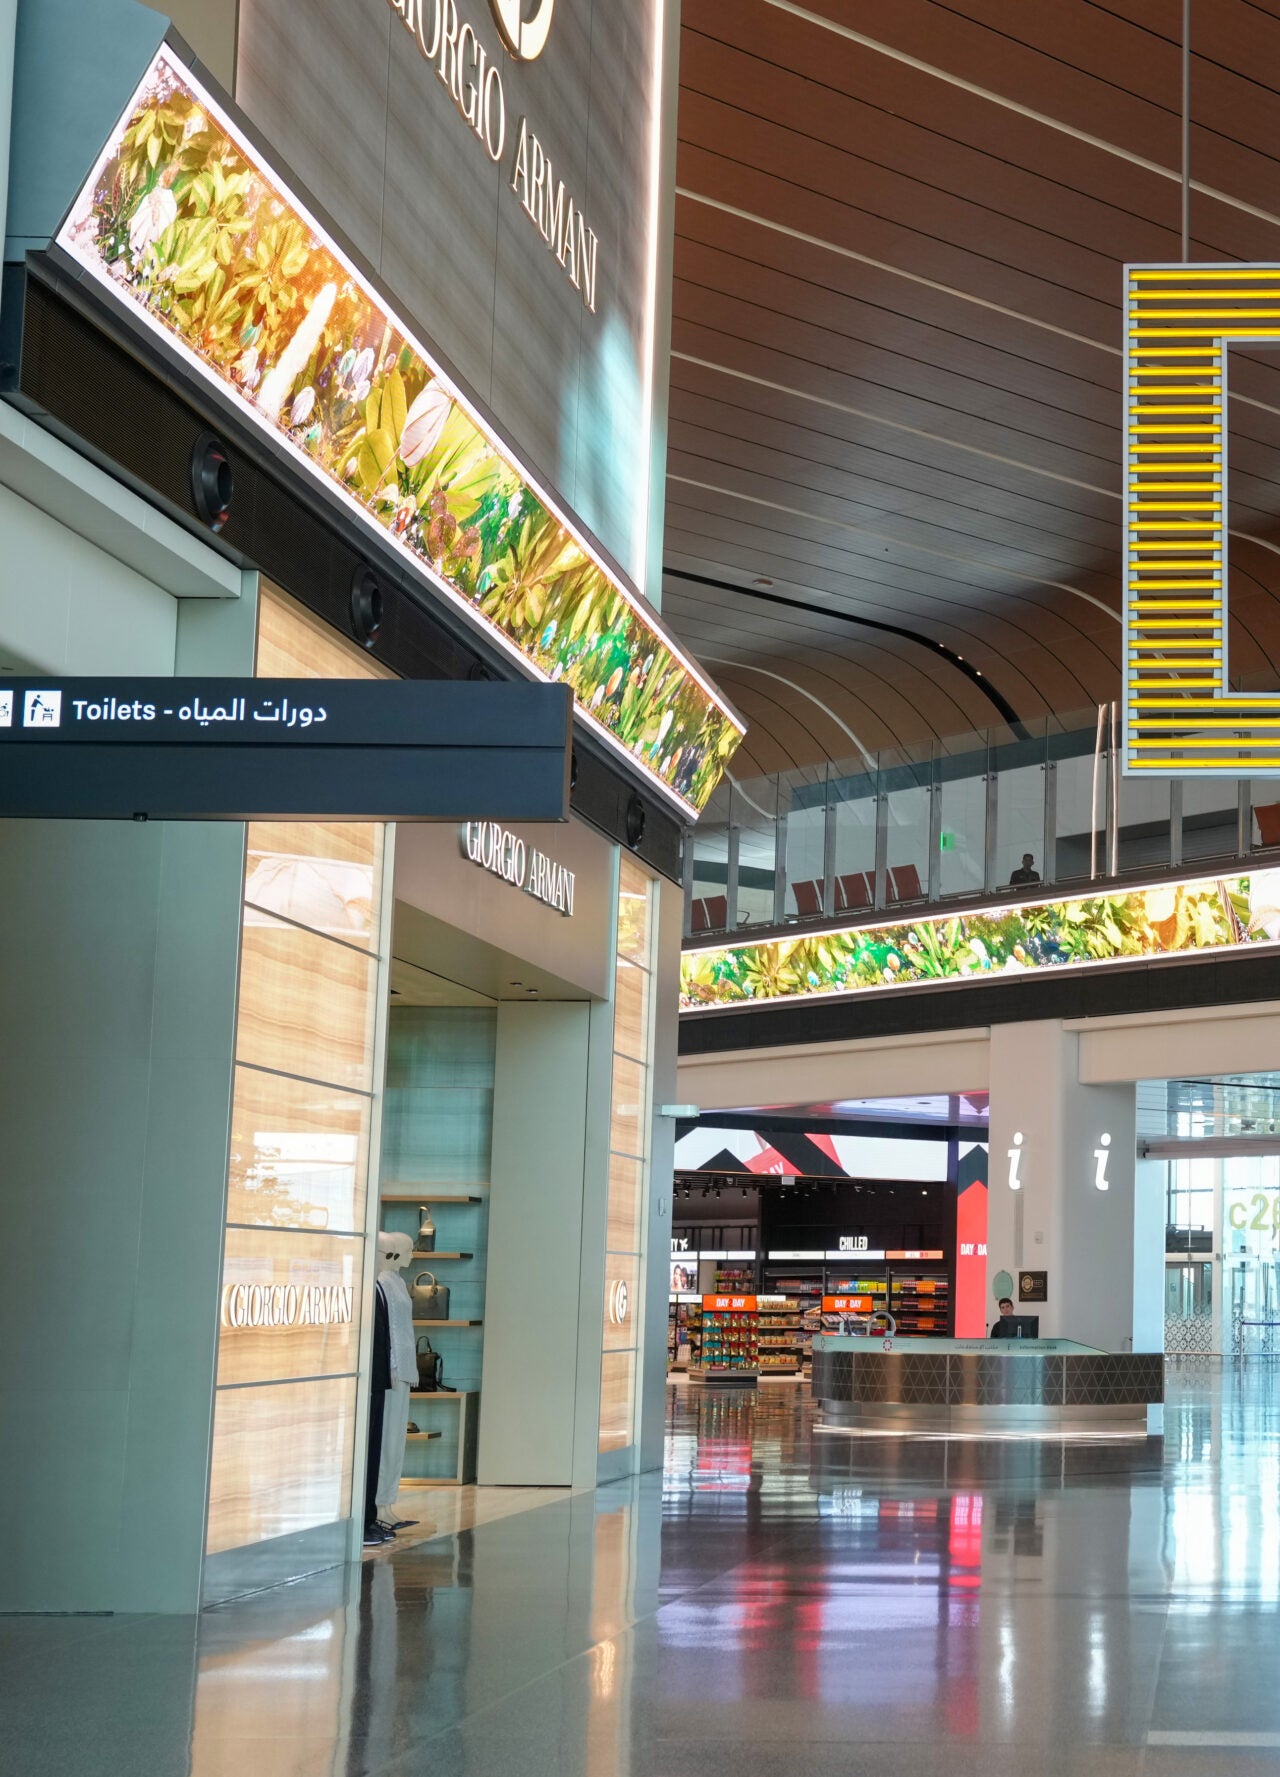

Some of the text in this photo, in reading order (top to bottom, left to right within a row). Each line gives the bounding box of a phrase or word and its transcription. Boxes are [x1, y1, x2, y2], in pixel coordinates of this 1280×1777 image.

[510, 116, 599, 314] ARMANI
[72, 698, 156, 721] Toilets
[178, 698, 245, 726] المياه
[253, 698, 327, 727] دورات
[466, 822, 576, 917] GIORGIO ARMANI
[839, 1236, 868, 1251] CHILLED
[229, 1284, 355, 1328] GIORGIO ARMANI
